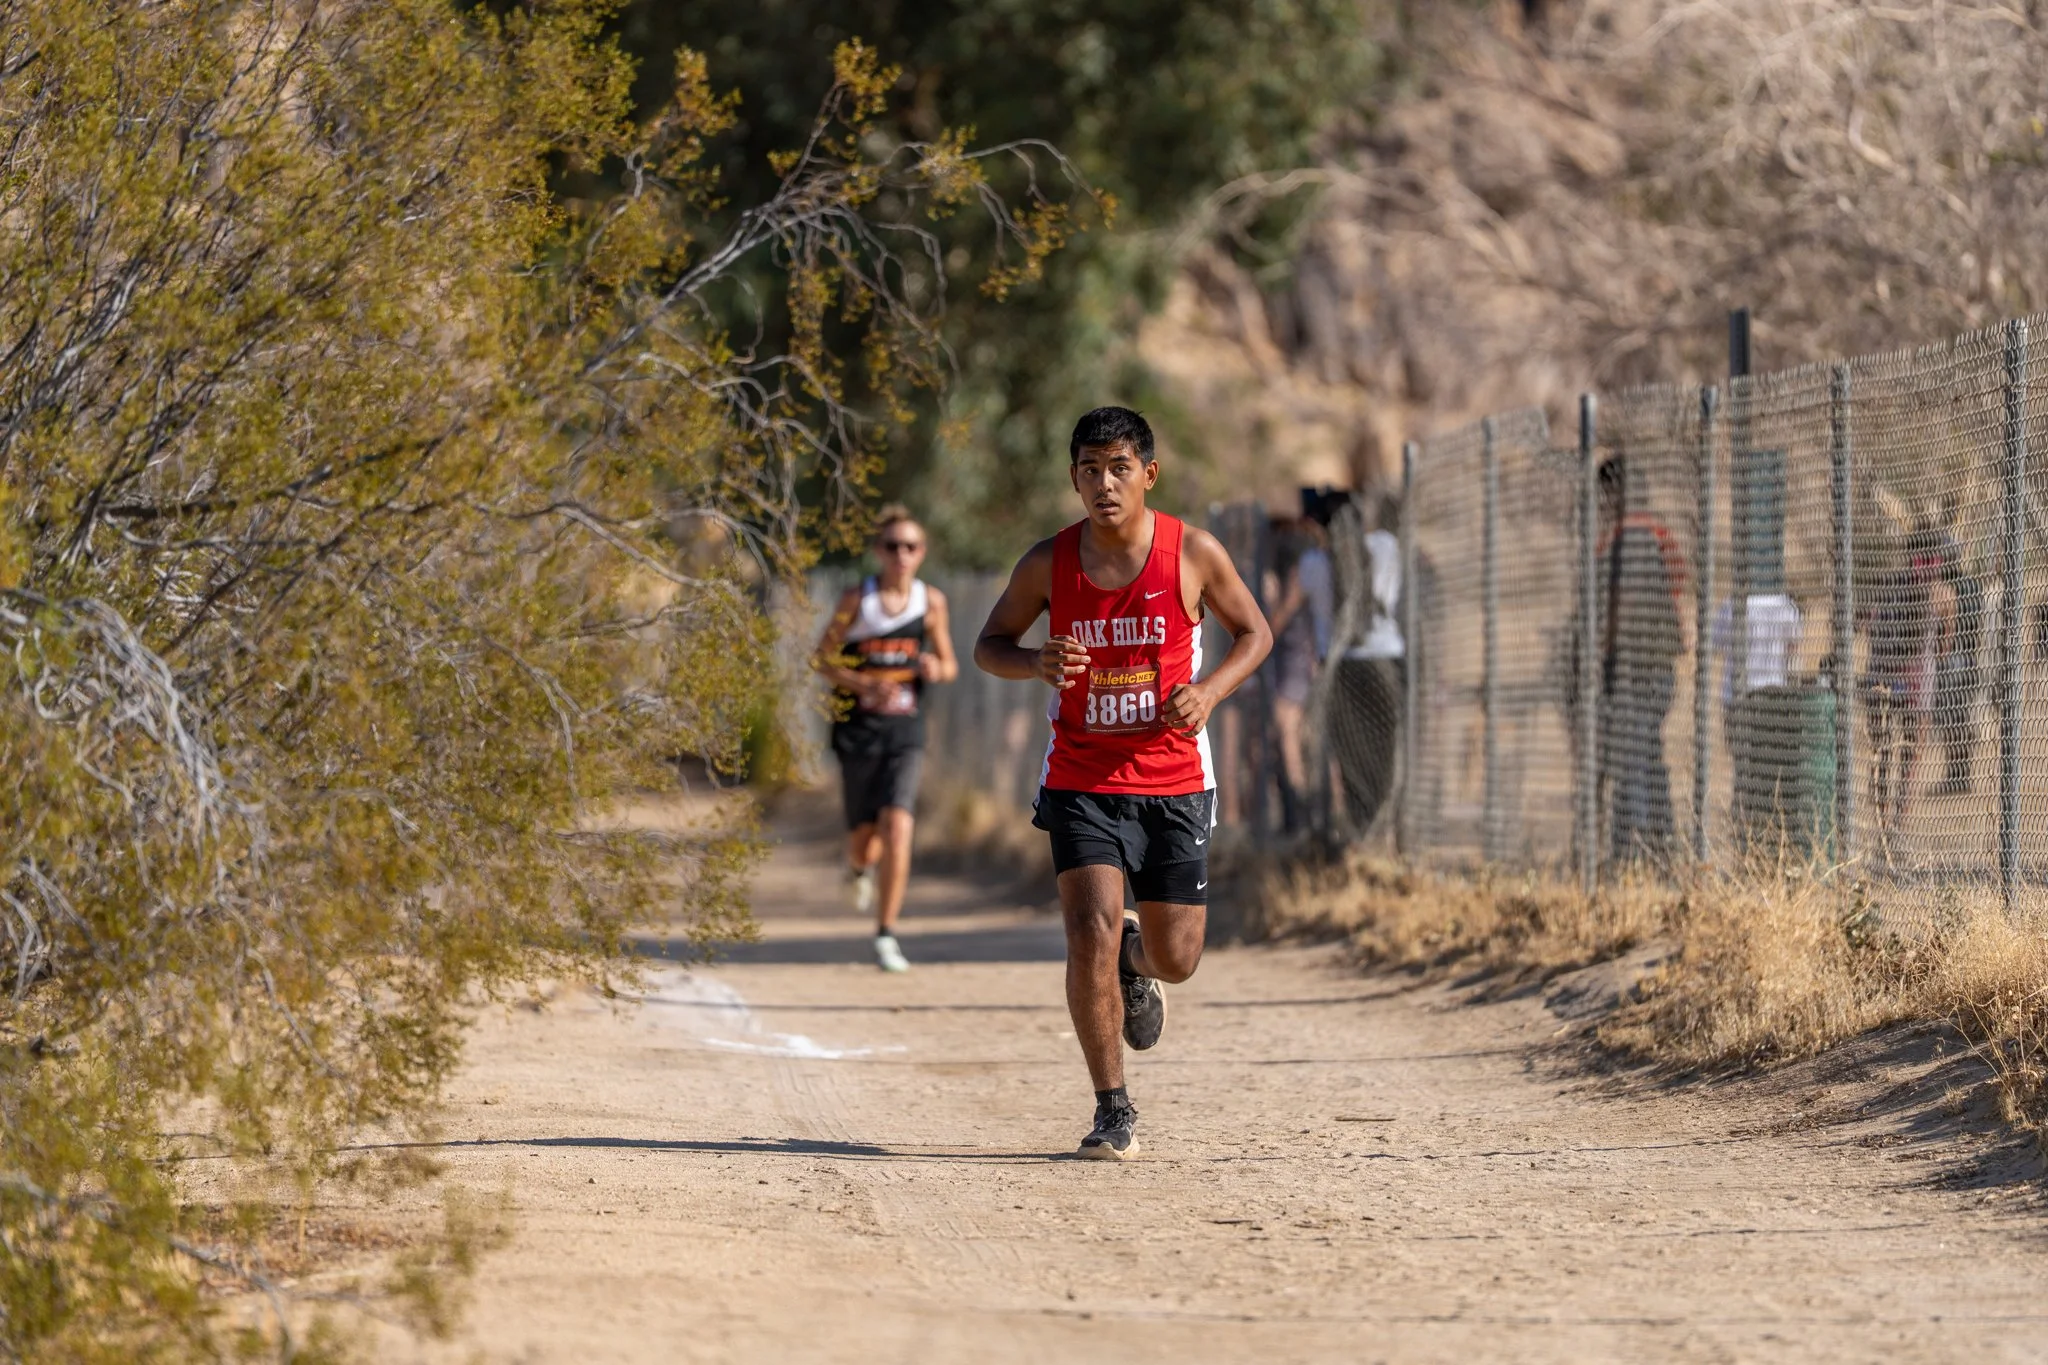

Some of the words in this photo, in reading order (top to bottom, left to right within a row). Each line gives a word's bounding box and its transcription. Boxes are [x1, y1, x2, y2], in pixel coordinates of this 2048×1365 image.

[1071, 619, 1108, 648] OAK
[1111, 616, 1166, 646] HILLS
[1086, 690, 1156, 725] 3860
